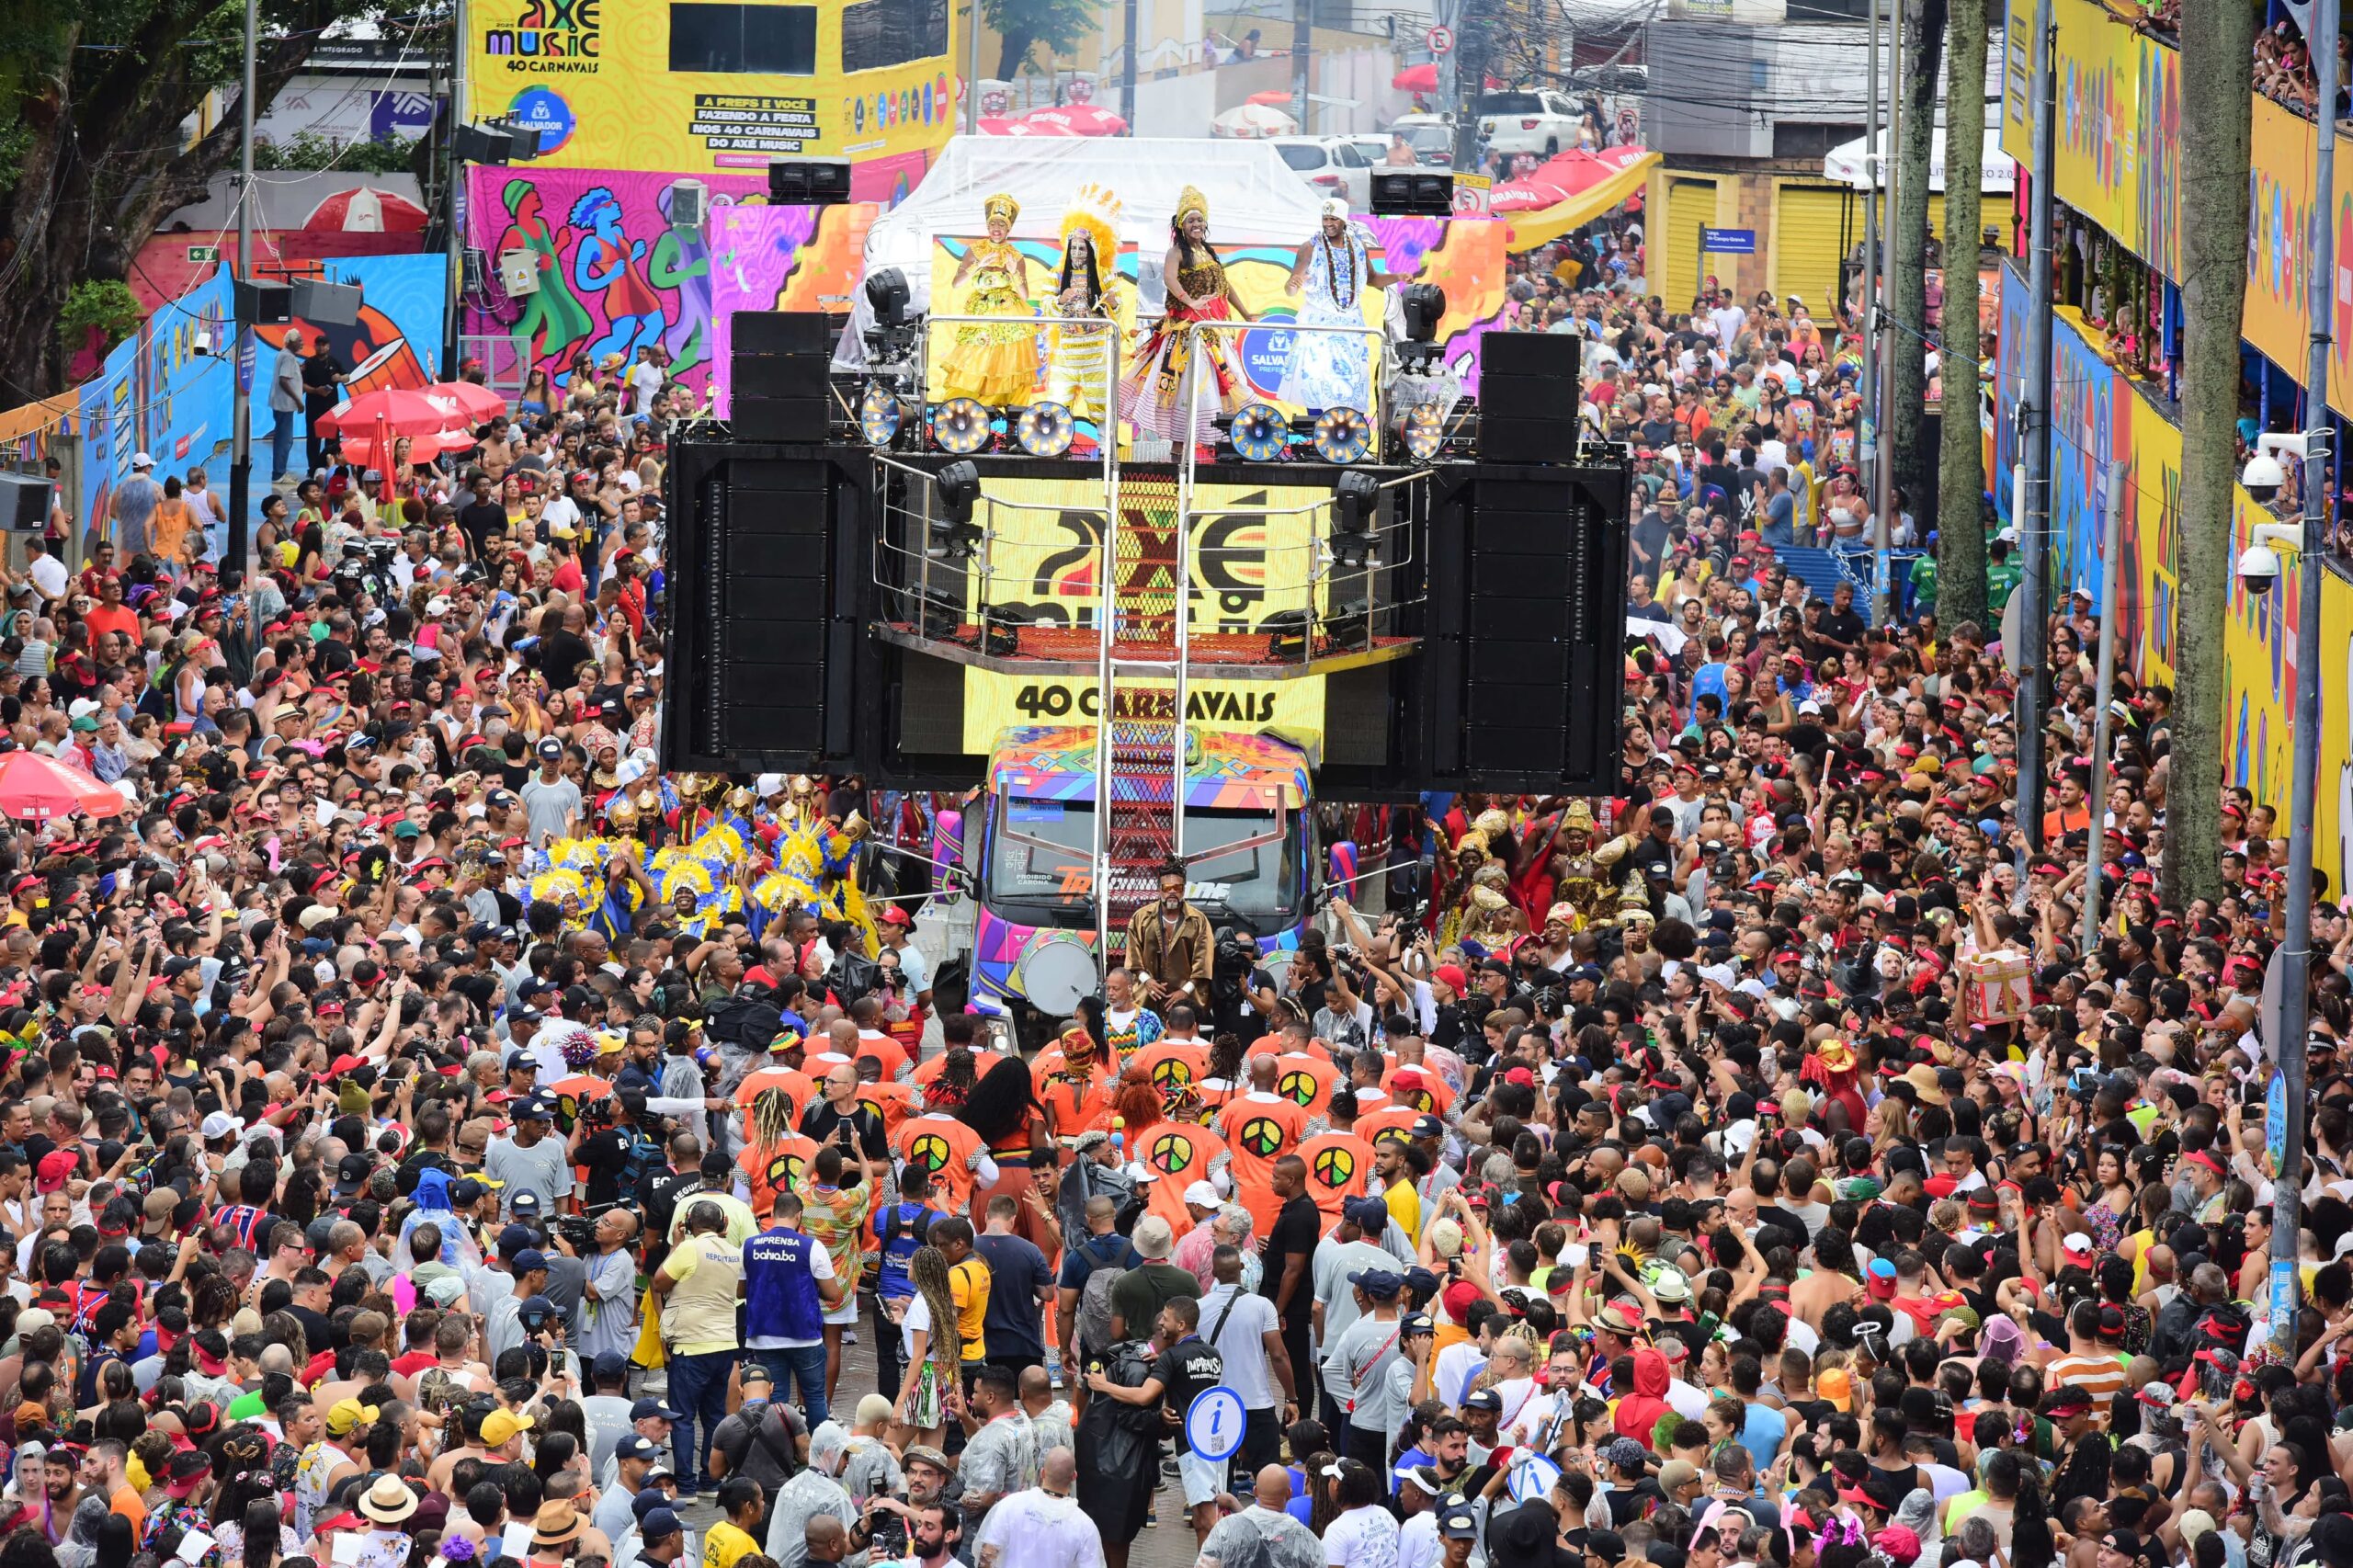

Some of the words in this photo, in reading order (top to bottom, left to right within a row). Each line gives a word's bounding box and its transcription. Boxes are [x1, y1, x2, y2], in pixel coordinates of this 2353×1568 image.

[506, 60, 527, 72] 40
[529, 61, 599, 73] CARNAVAIS
[704, 97, 713, 107] A
[717, 97, 759, 108] PREFS
[762, 99, 770, 108] E
[774, 99, 808, 110] VOCÊ
[698, 109, 757, 121] FAZENDO
[760, 112, 770, 122] A
[773, 112, 812, 124] FESTA
[692, 123, 722, 134] NOS
[724, 125, 742, 135] 40
[745, 125, 816, 138] CARNAVAIS
[709, 137, 729, 148] DO
[732, 137, 757, 149] AXÉ
[759, 140, 800, 151] MUSIC
[1998, 169, 2013, 178] 2.0
[1490, 189, 1539, 204] BRAHMA
[1251, 354, 1287, 366] SALVA
[1016, 685, 1073, 719] 40
[753, 1236, 801, 1247] IMPRENSA
[753, 1249, 796, 1262] bahia.ba
[2252, 1540, 2271, 1556] REEF
